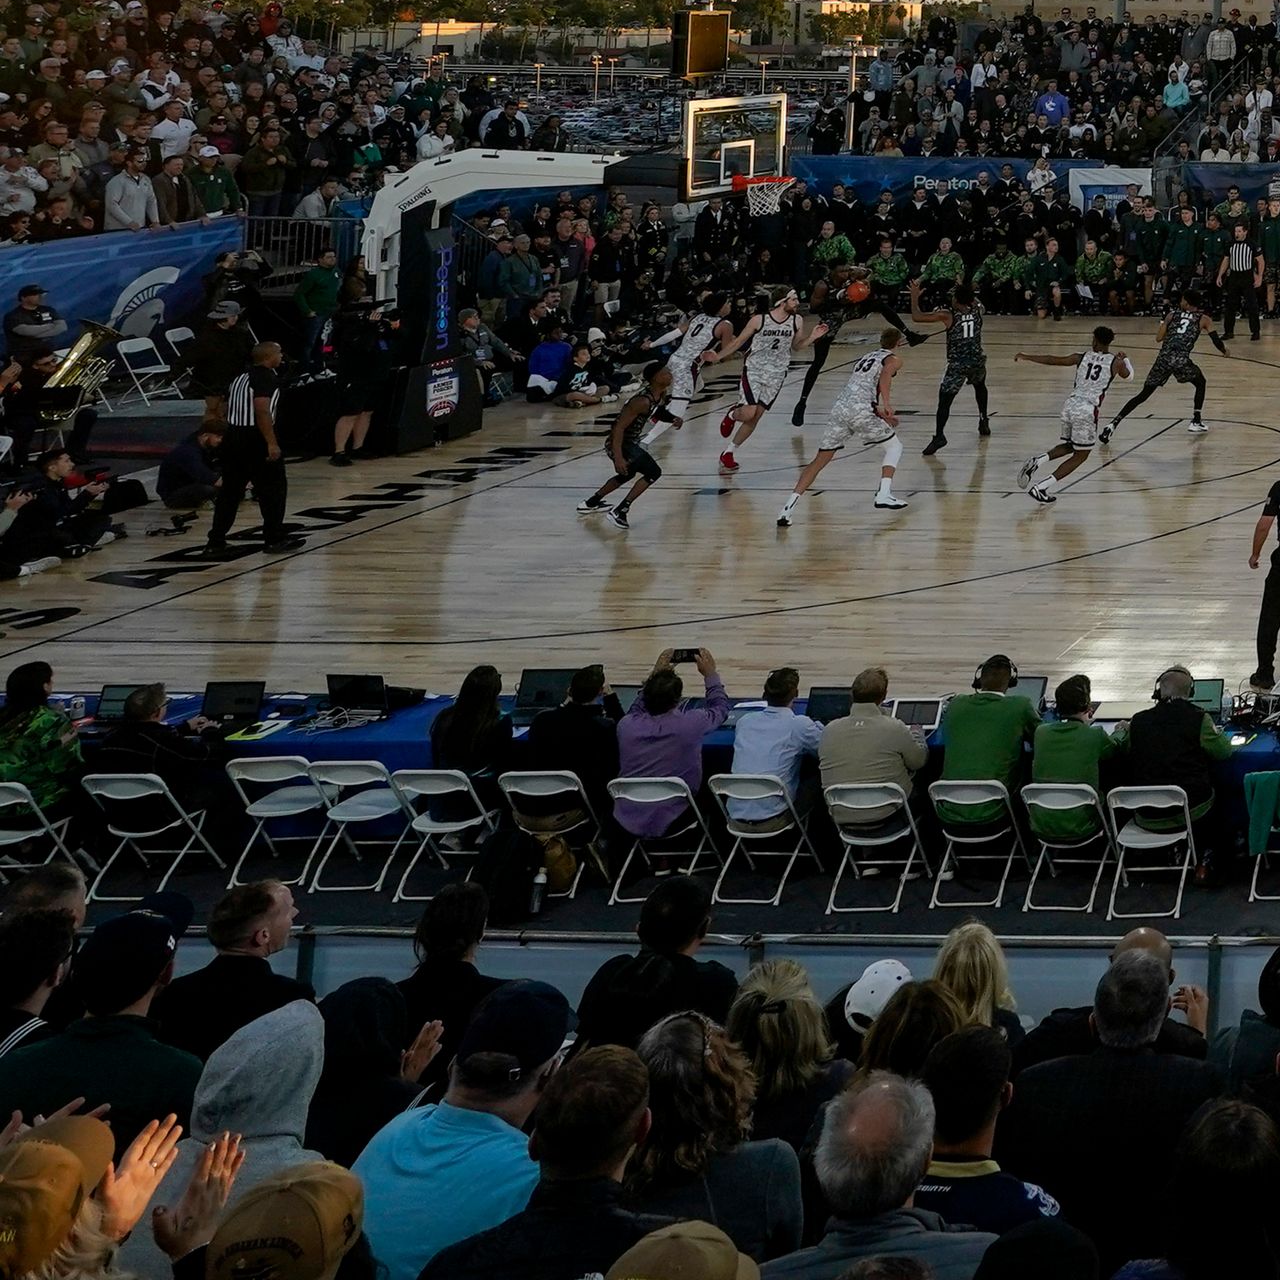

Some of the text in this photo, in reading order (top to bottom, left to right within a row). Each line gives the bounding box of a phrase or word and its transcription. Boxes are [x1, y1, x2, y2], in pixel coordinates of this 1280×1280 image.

[436, 244, 453, 351] Peraton
[691, 323, 704, 338] 0
[961, 320, 975, 338] 11
[1177, 318, 1190, 334] 3
[771, 339, 780, 350] 2
[855, 358, 876, 373] 33
[1086, 362, 1103, 381] 13
